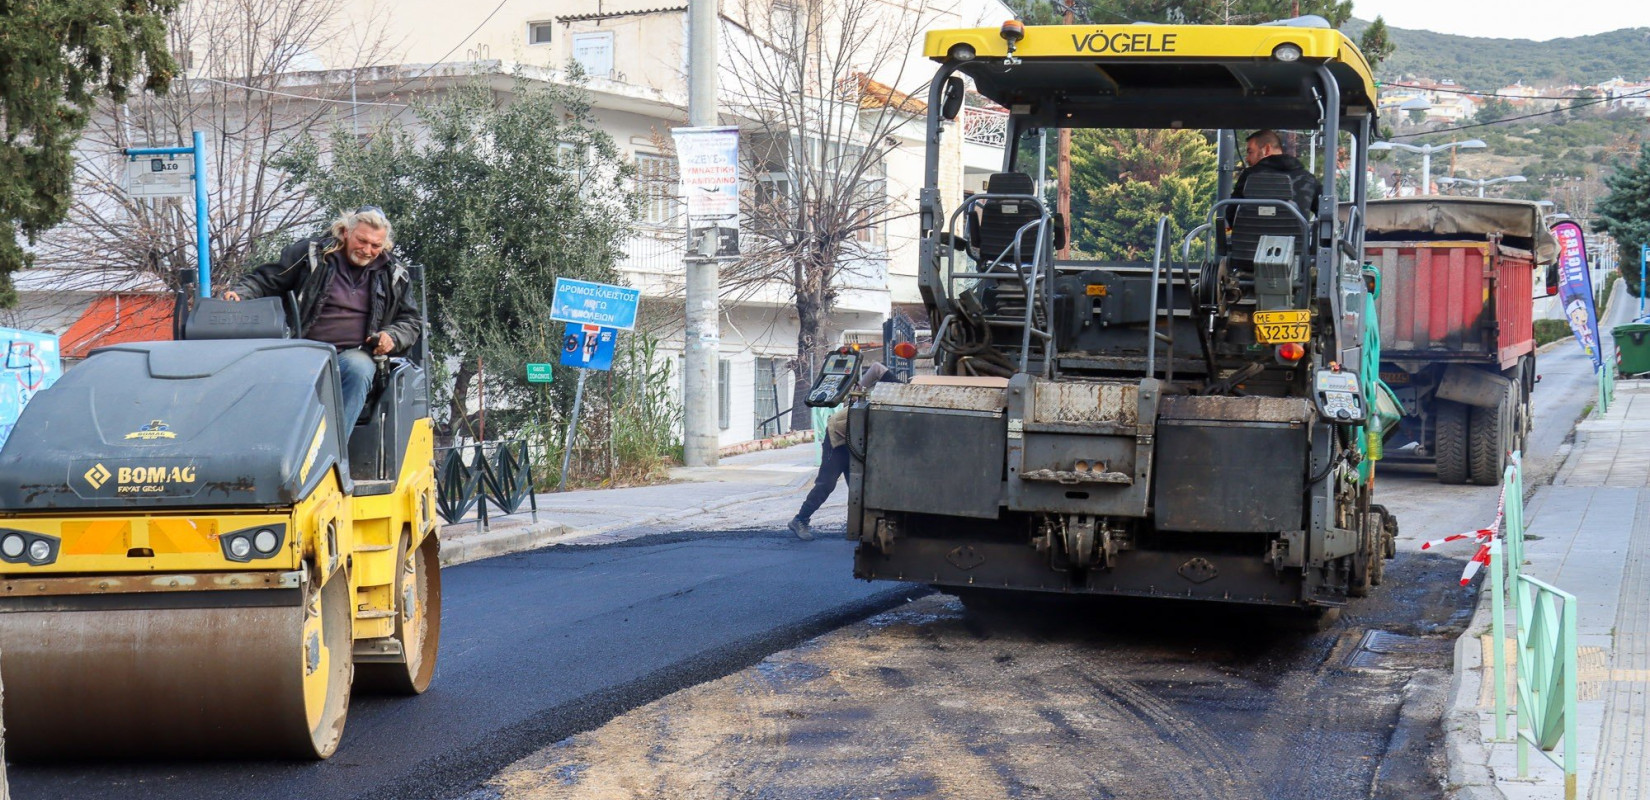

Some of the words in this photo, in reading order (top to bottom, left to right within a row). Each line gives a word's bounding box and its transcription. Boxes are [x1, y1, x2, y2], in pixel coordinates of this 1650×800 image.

[1071, 29, 1177, 53] VÖGELE
[684, 166, 735, 175] ΥΜΝΑΣΤΙΚΗ
[685, 177, 736, 185] ΡΑΜΠΟΛΙΝΟ
[559, 284, 594, 297] ΔΡΟΜΟΣ
[595, 289, 635, 302] ΚΛΕΙΣΤΟΣ
[583, 299, 607, 310] ΛΓΩ
[571, 309, 614, 323] ΟΛΕΙΩΝ
[118, 466, 196, 484] BOMAG
[117, 485, 141, 493] FAYAT
